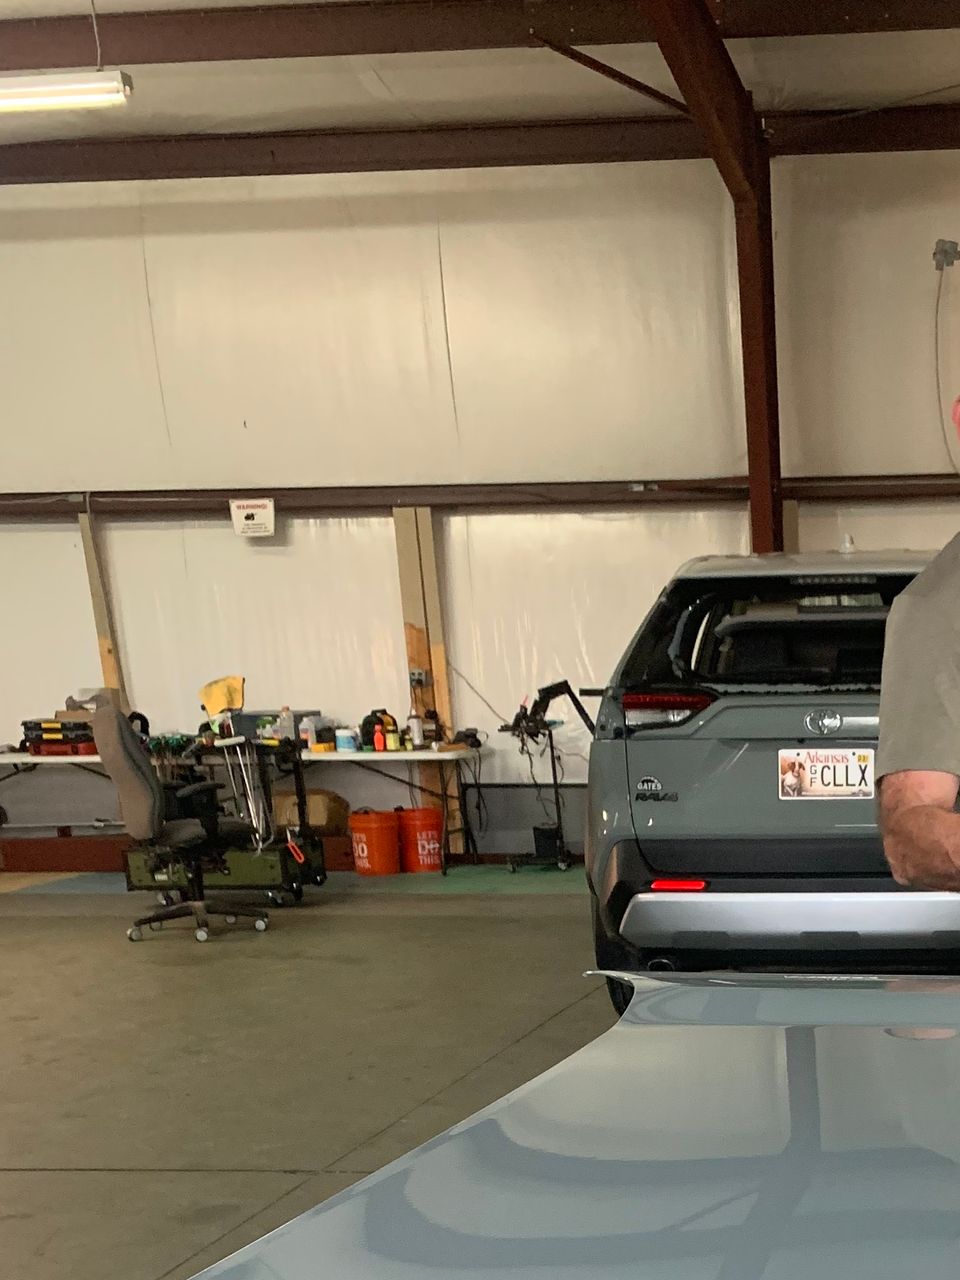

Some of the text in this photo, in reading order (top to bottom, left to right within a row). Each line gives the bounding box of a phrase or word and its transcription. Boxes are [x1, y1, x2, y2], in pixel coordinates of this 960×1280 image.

[804, 751, 849, 764] Arkansas
[821, 764, 868, 787] CLLX
[637, 782, 662, 791] GATES
